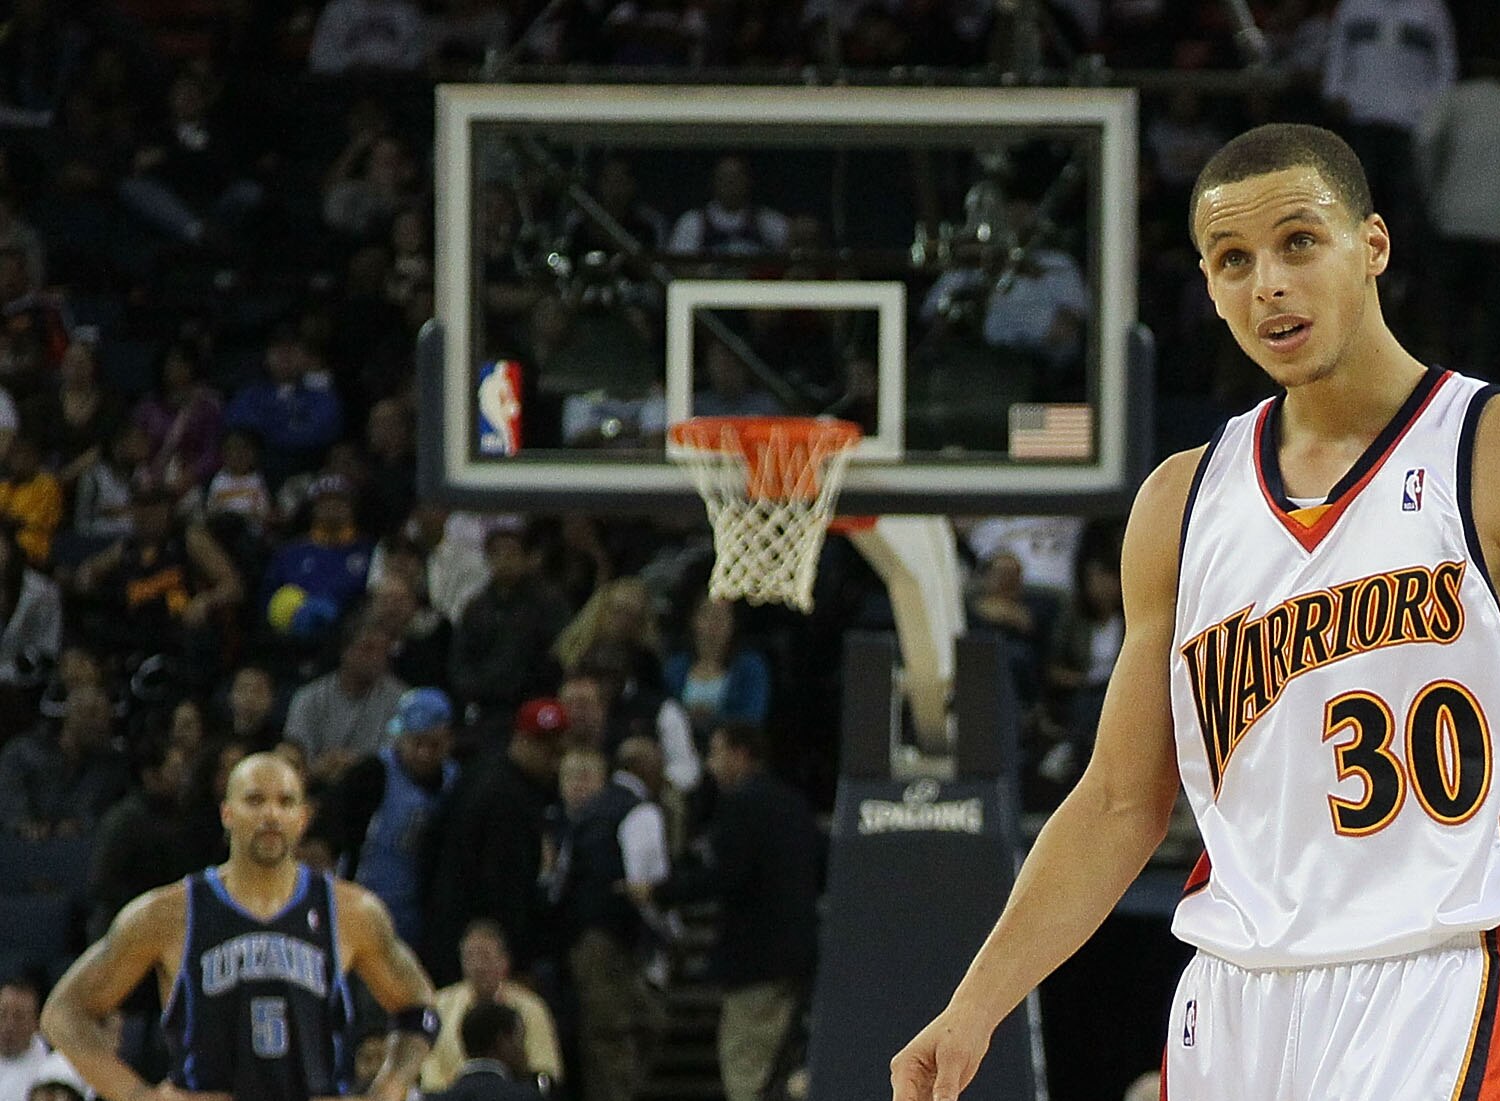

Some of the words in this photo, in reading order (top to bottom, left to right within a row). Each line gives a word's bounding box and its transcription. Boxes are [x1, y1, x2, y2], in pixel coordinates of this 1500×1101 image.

[1180, 559, 1467, 806] WARRIORS
[1322, 679, 1494, 838] 30
[201, 932, 327, 998] UTAH
[251, 996, 290, 1059] 5
